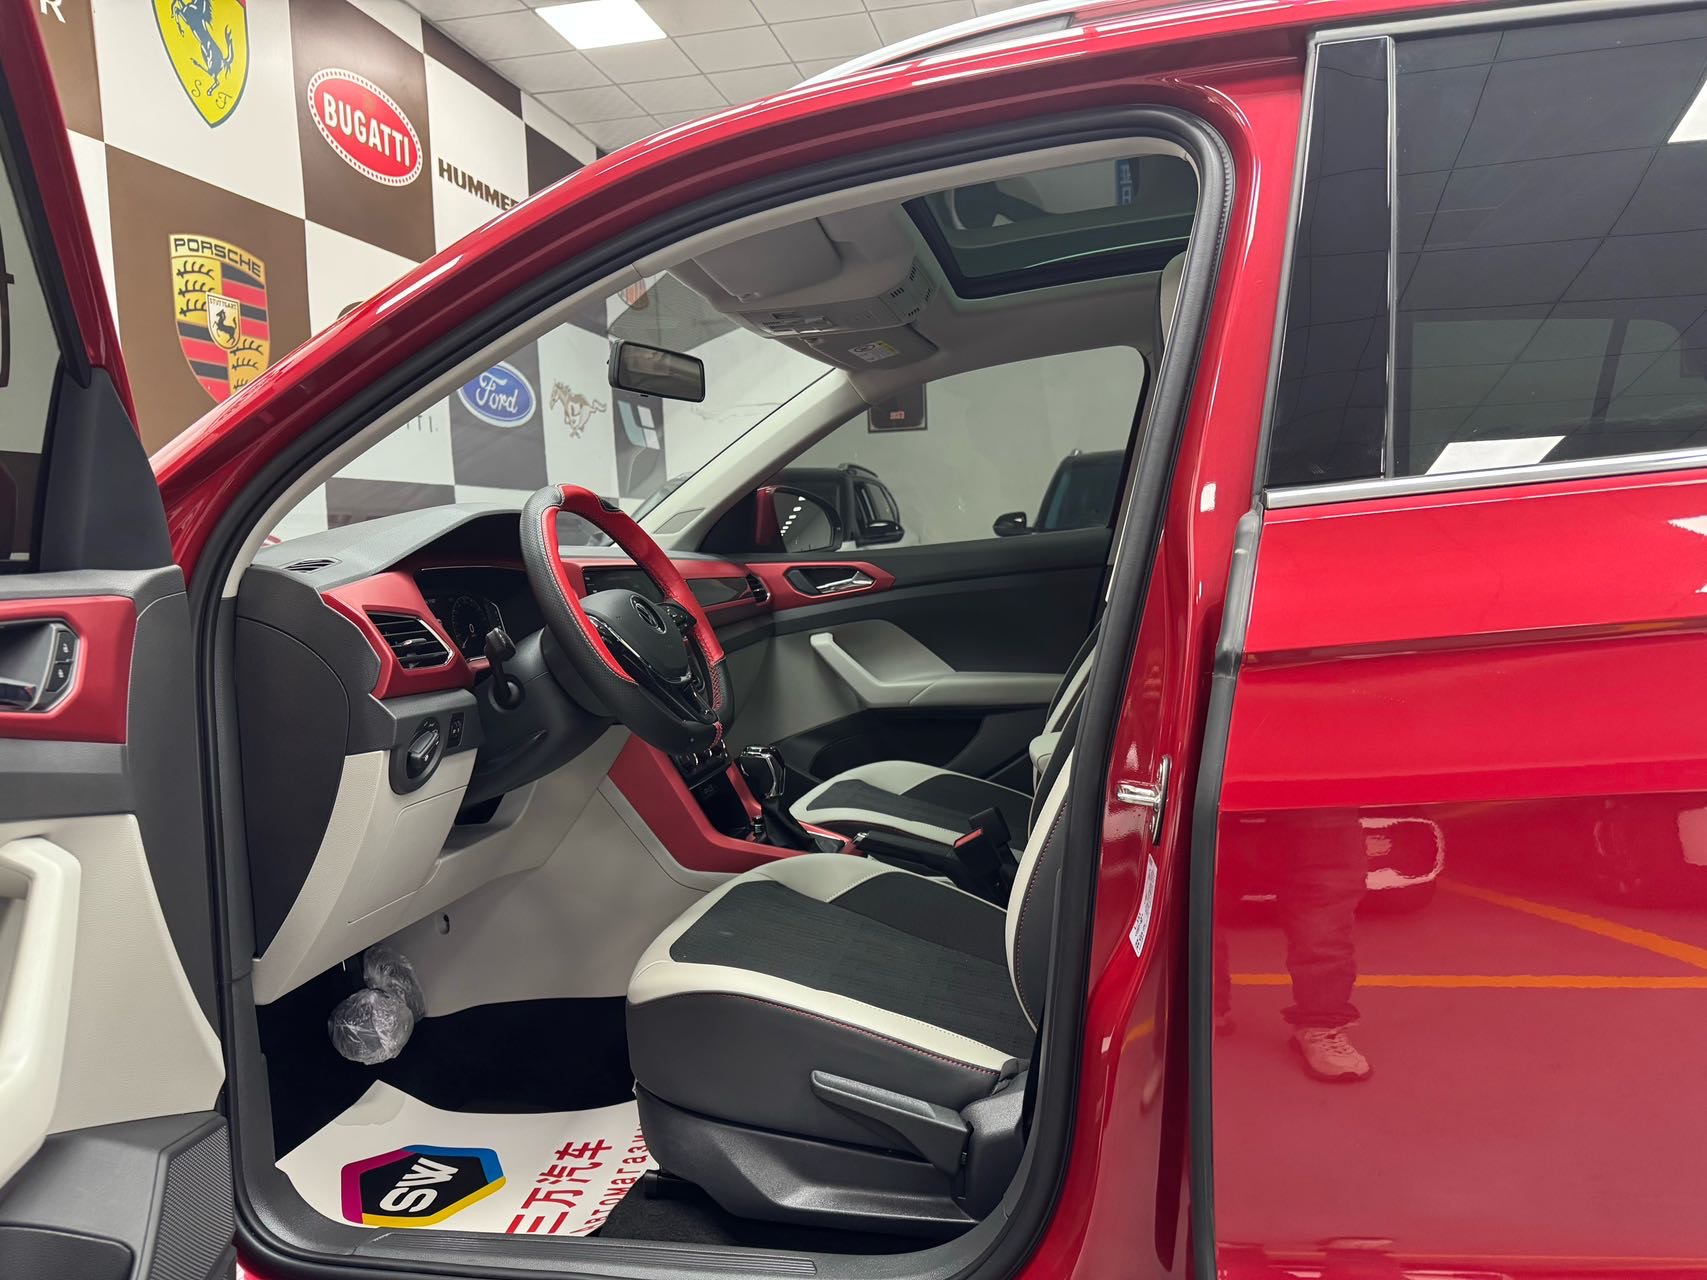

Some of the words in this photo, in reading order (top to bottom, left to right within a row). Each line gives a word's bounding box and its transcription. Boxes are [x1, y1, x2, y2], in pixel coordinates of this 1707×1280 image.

[322, 91, 411, 167] BUGATTI
[173, 238, 262, 279] PORSCHE
[475, 372, 519, 414] Ford
[379, 1157, 459, 1213] SW
[505, 1139, 613, 1234] 三万汽车
